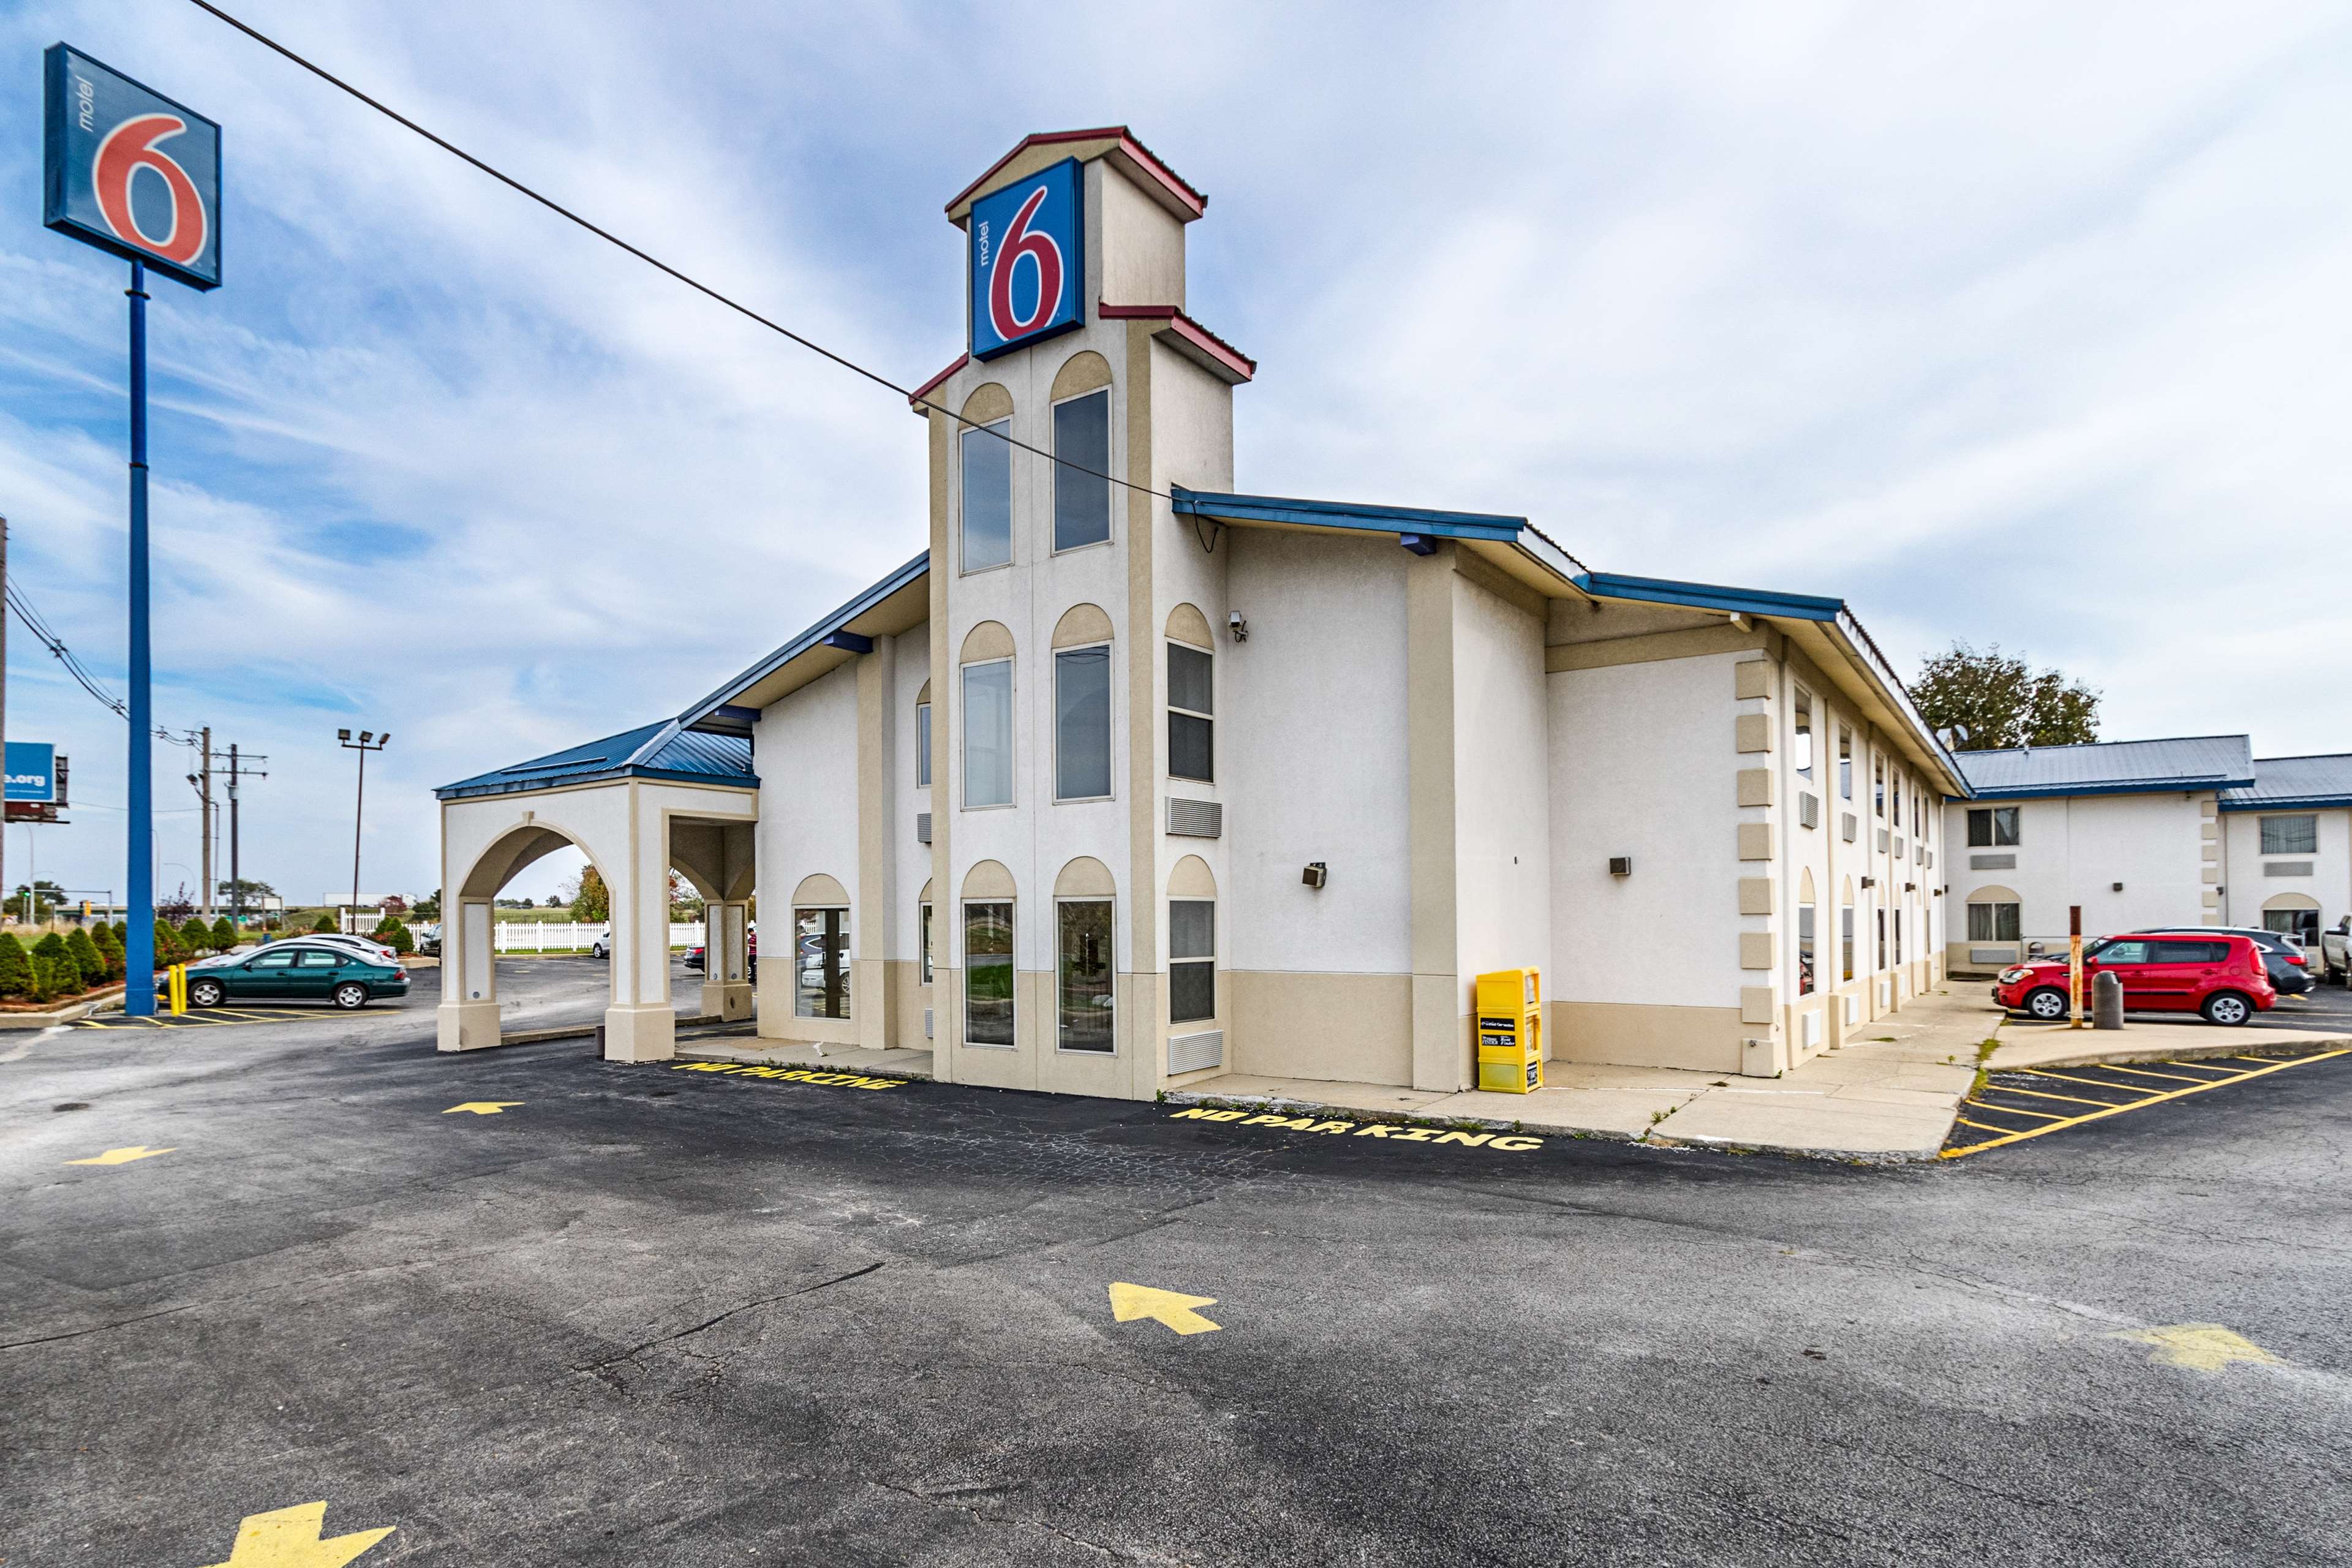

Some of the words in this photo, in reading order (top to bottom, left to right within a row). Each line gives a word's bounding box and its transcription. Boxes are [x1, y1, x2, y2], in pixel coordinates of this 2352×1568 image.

[75, 75, 94, 132] motel
[92, 112, 208, 266] 6
[978, 221, 989, 266] motel
[989, 185, 1065, 342] 6
[671, 1062, 743, 1072] NO
[723, 1066, 908, 1090] PARKING
[1169, 1109, 1250, 1121] NO
